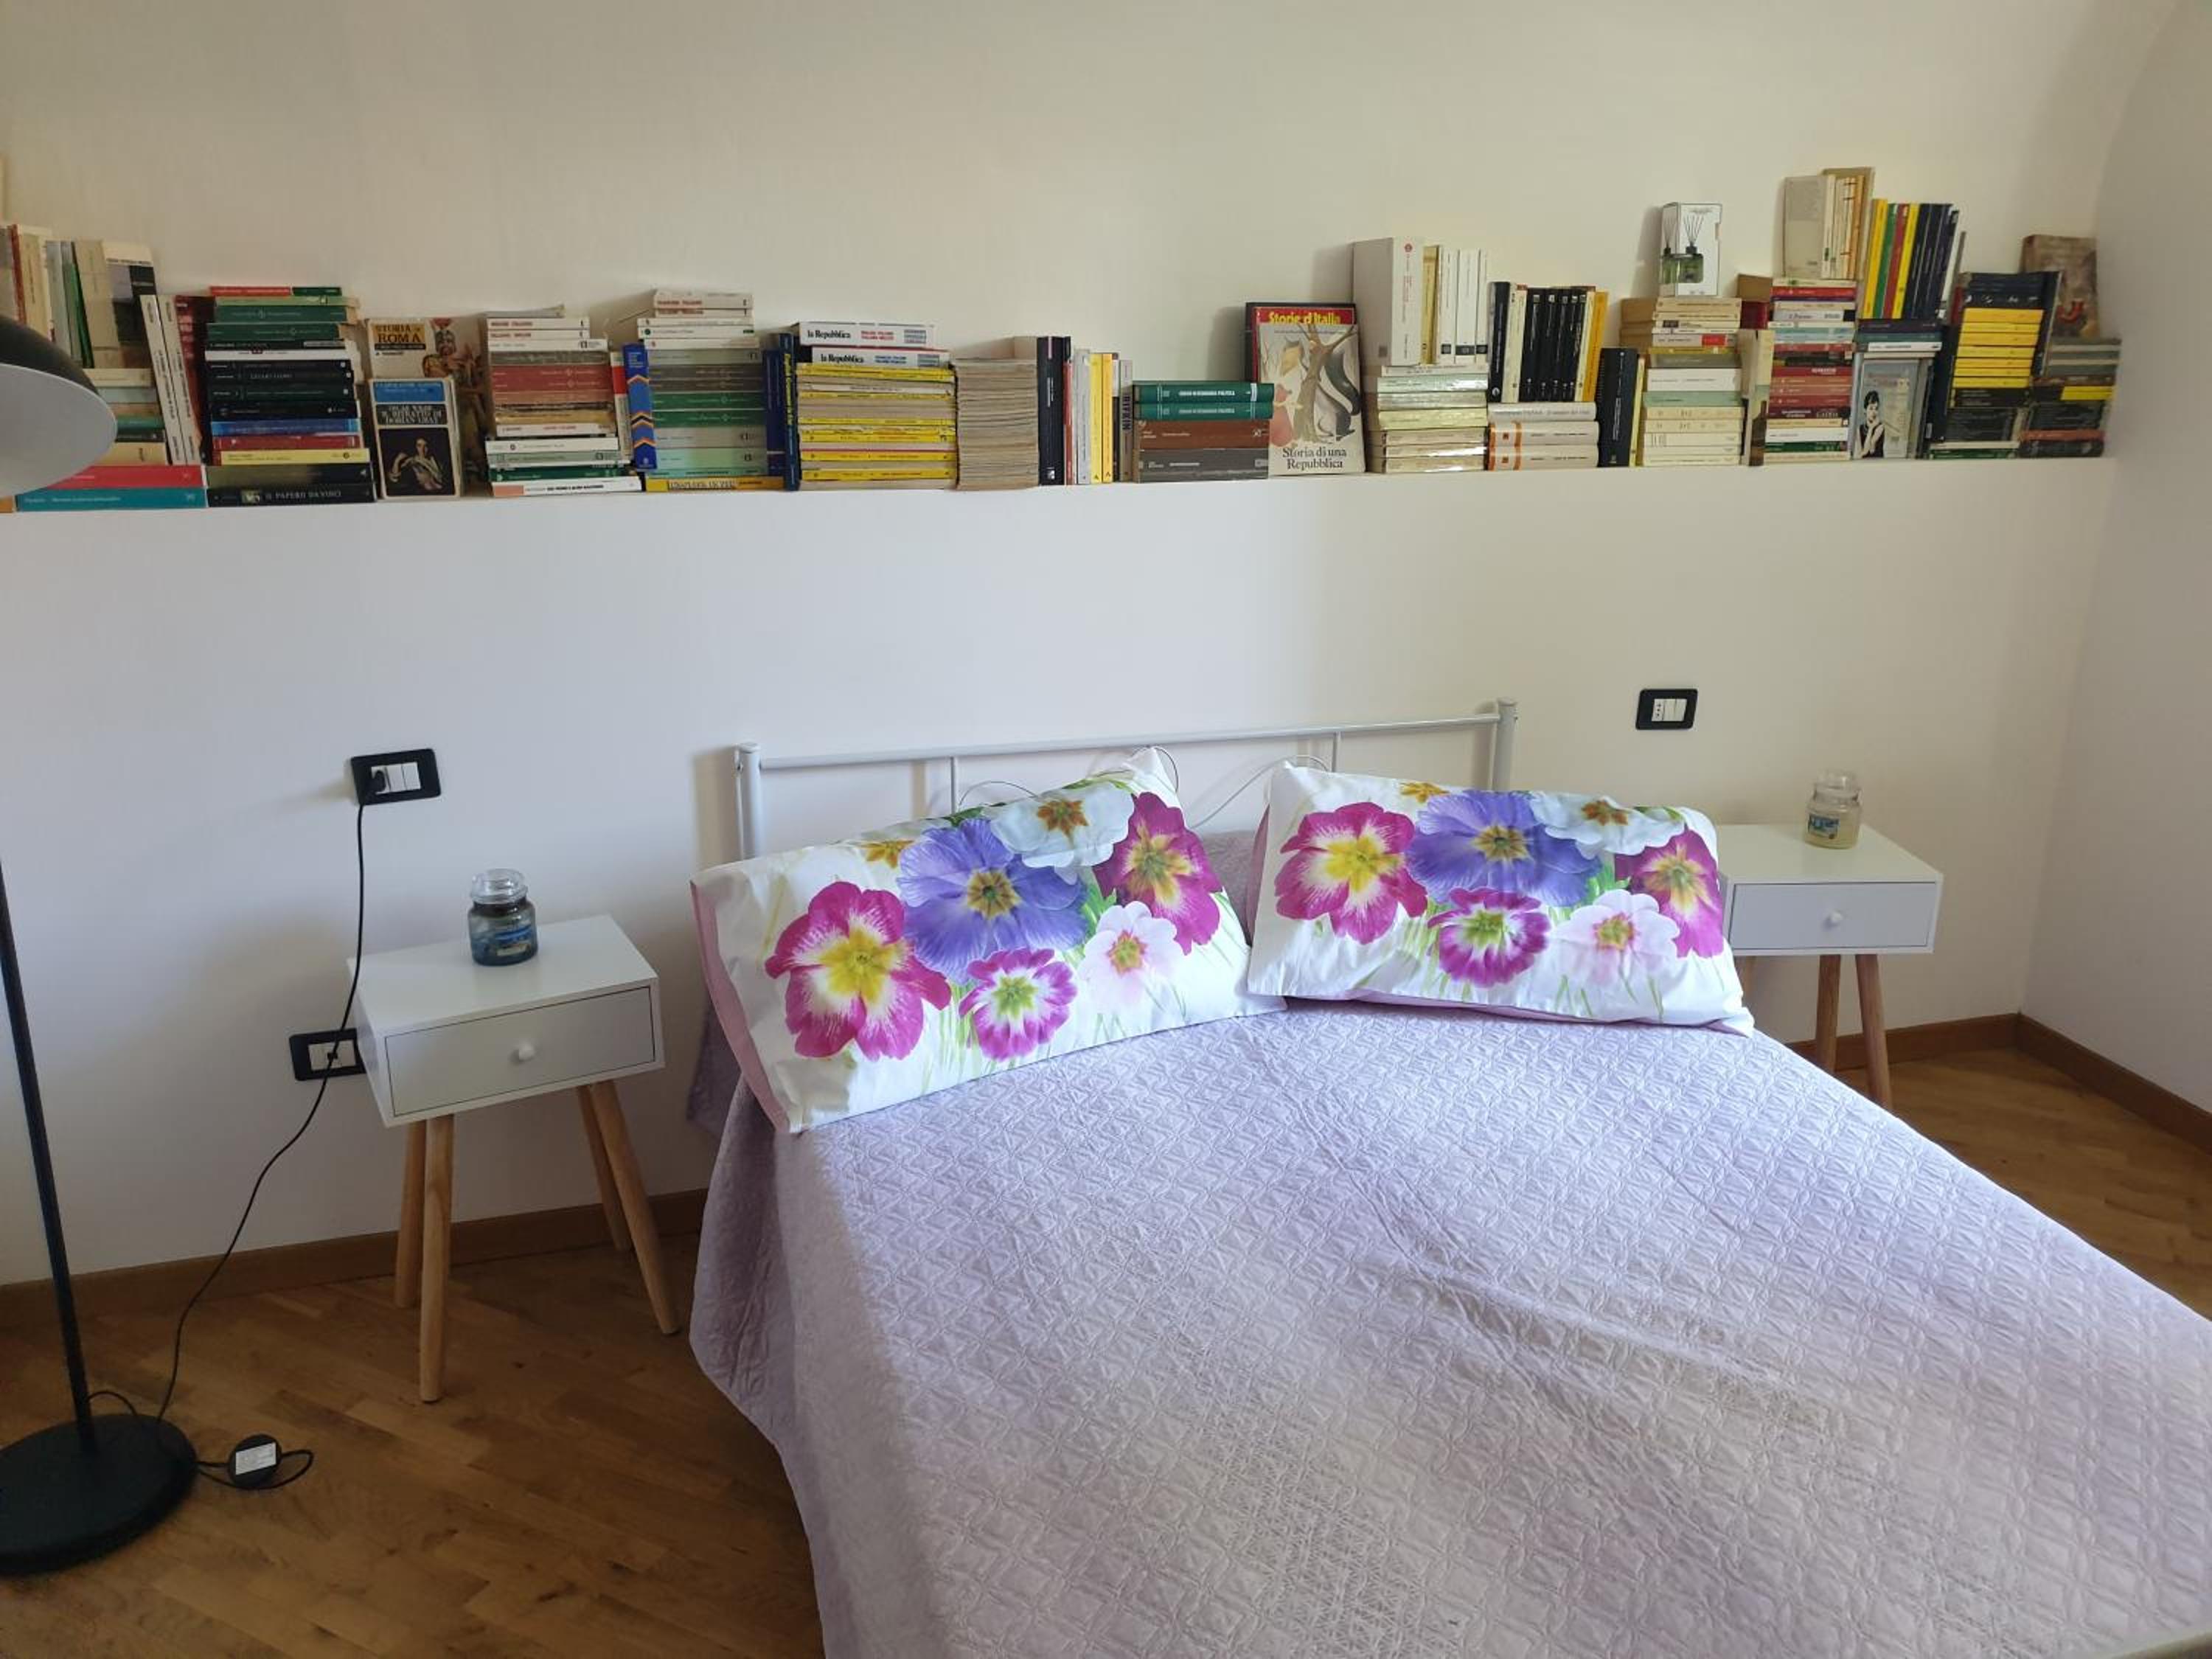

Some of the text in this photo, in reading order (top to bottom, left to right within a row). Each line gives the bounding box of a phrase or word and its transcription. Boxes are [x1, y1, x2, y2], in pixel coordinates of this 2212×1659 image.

[1269, 311, 1300, 323] Storie
[378, 333, 421, 343] ROMA
[807, 330, 814, 338] la
[815, 330, 851, 339] Repubblica
[821, 353, 864, 363] la Repubblica
[1282, 446, 1347, 458] Storia di una
[1287, 458, 1343, 471] Repubblica
